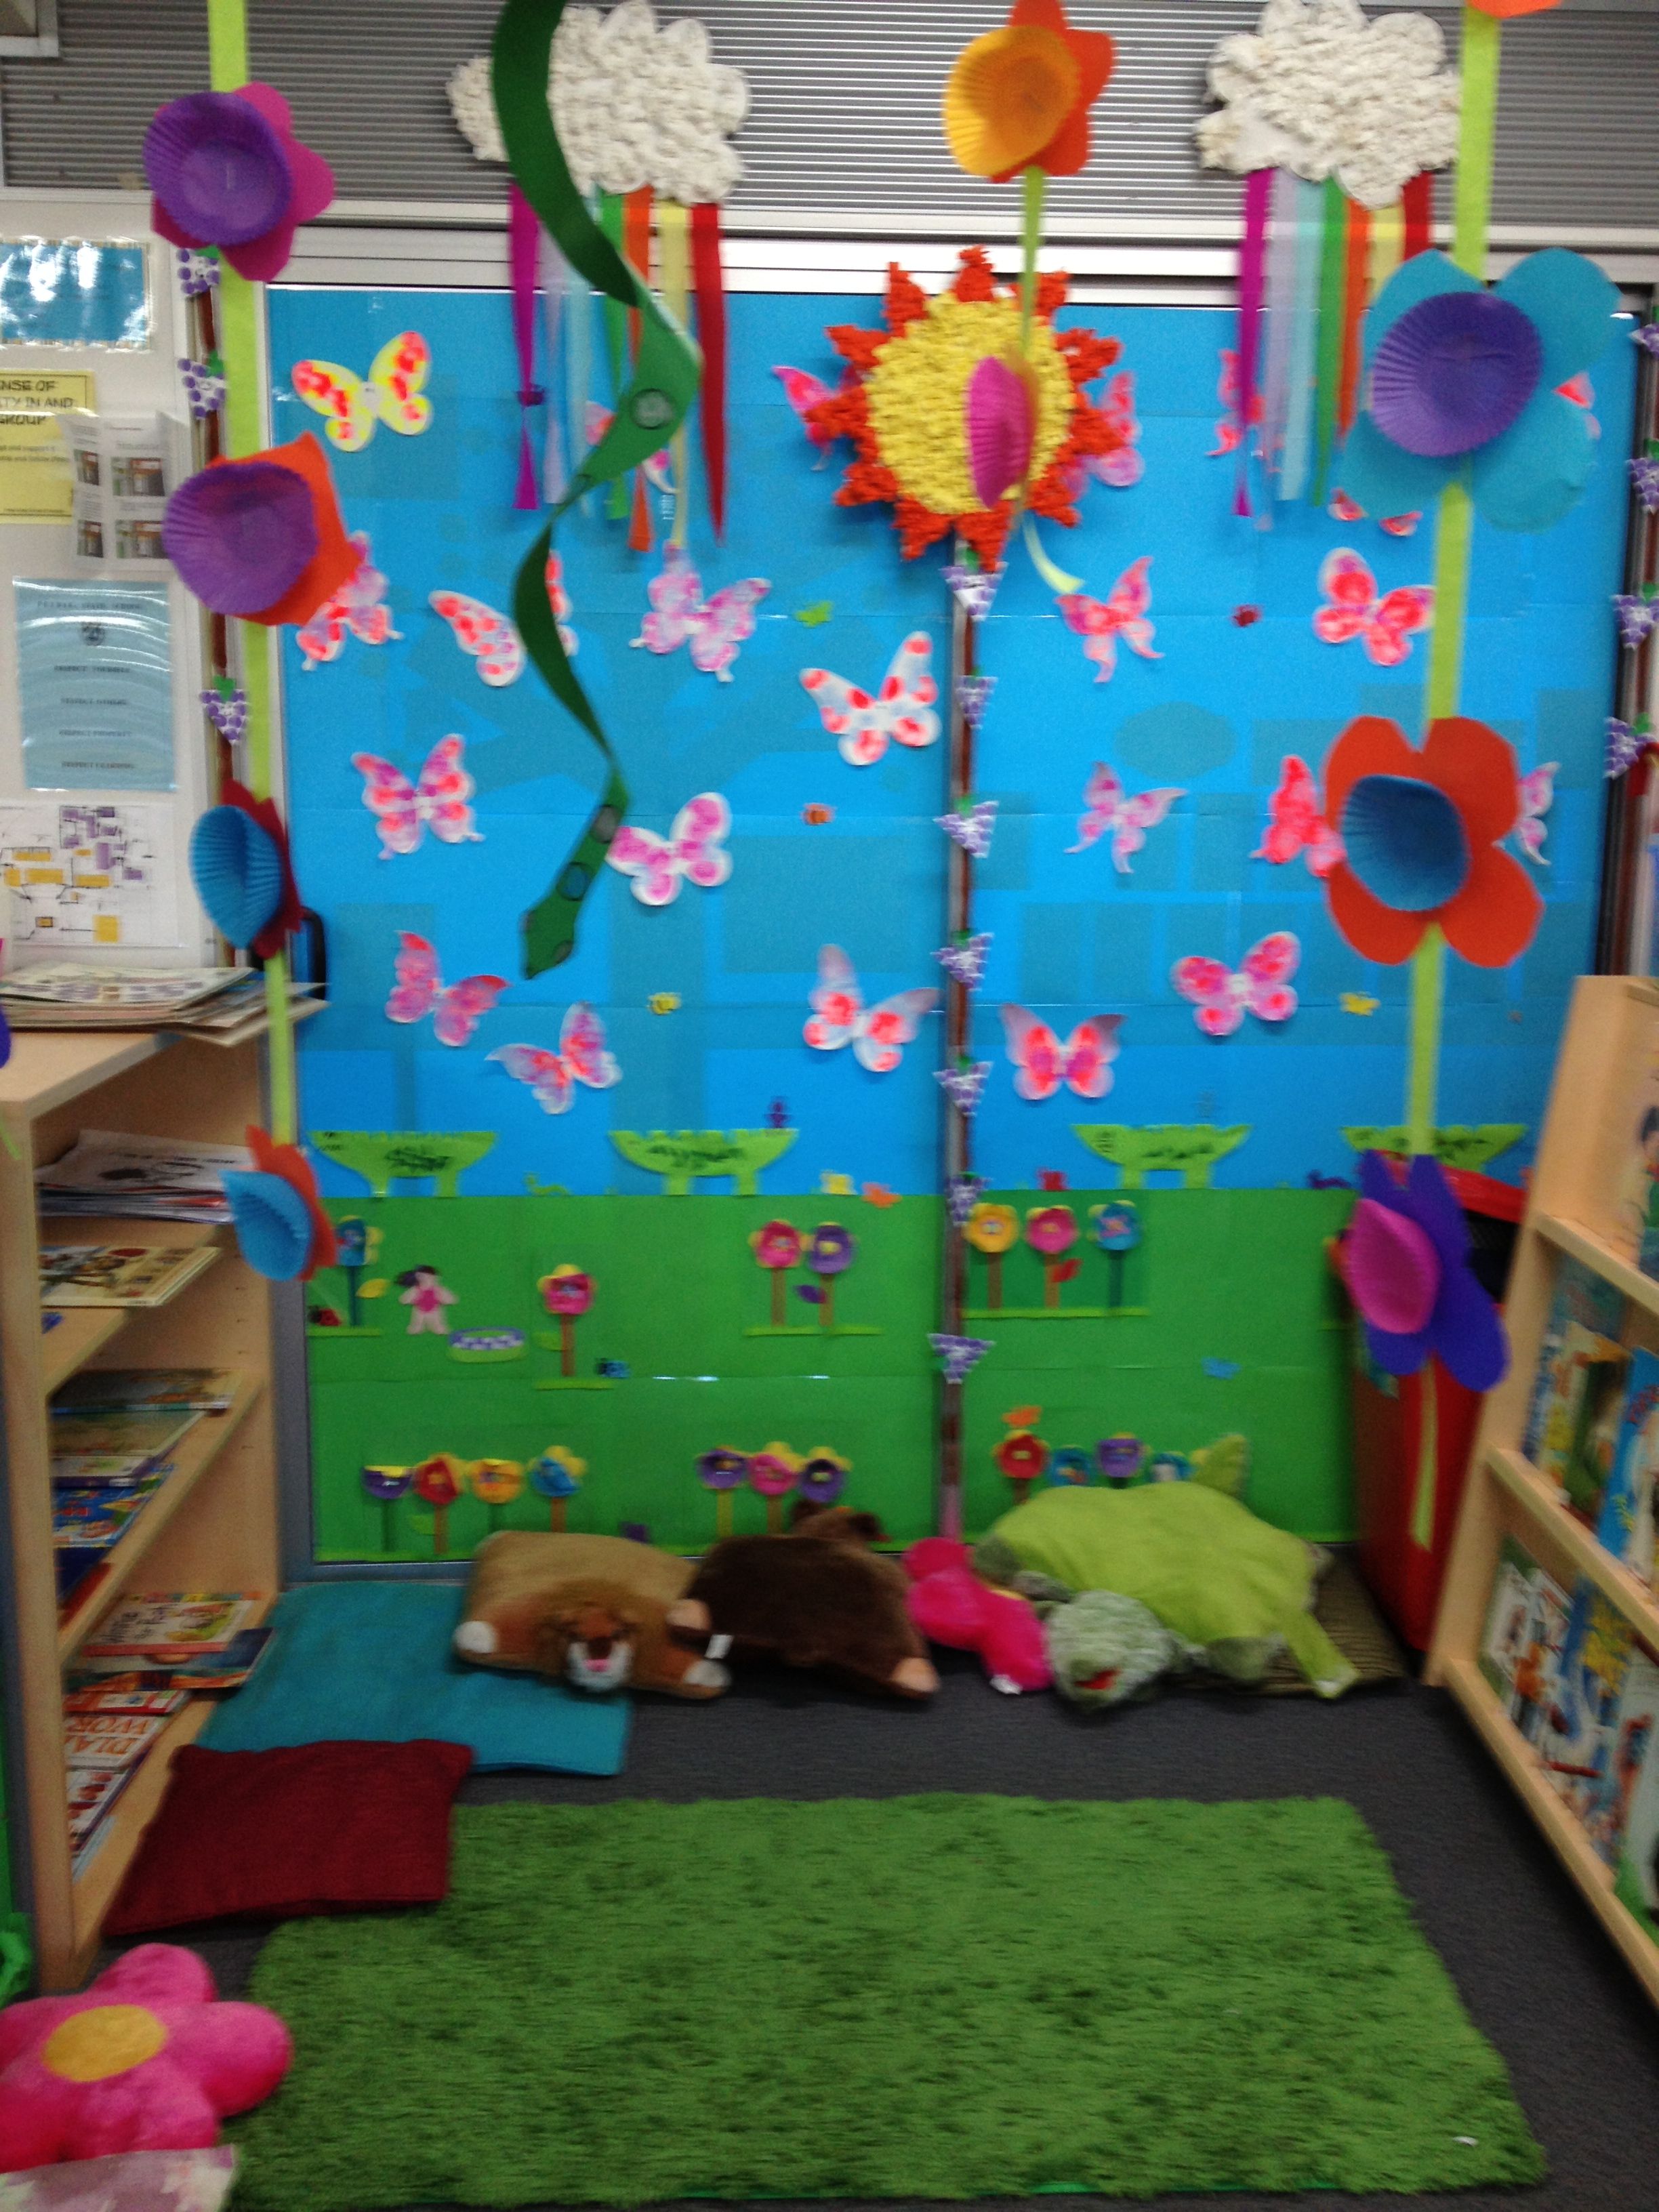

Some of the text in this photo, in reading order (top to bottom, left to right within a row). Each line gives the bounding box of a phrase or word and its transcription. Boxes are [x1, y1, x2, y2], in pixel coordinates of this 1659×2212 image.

[0, 380, 56, 392] NSE OF
[0, 396, 21, 407] TY
[44, 397, 74, 408] AND
